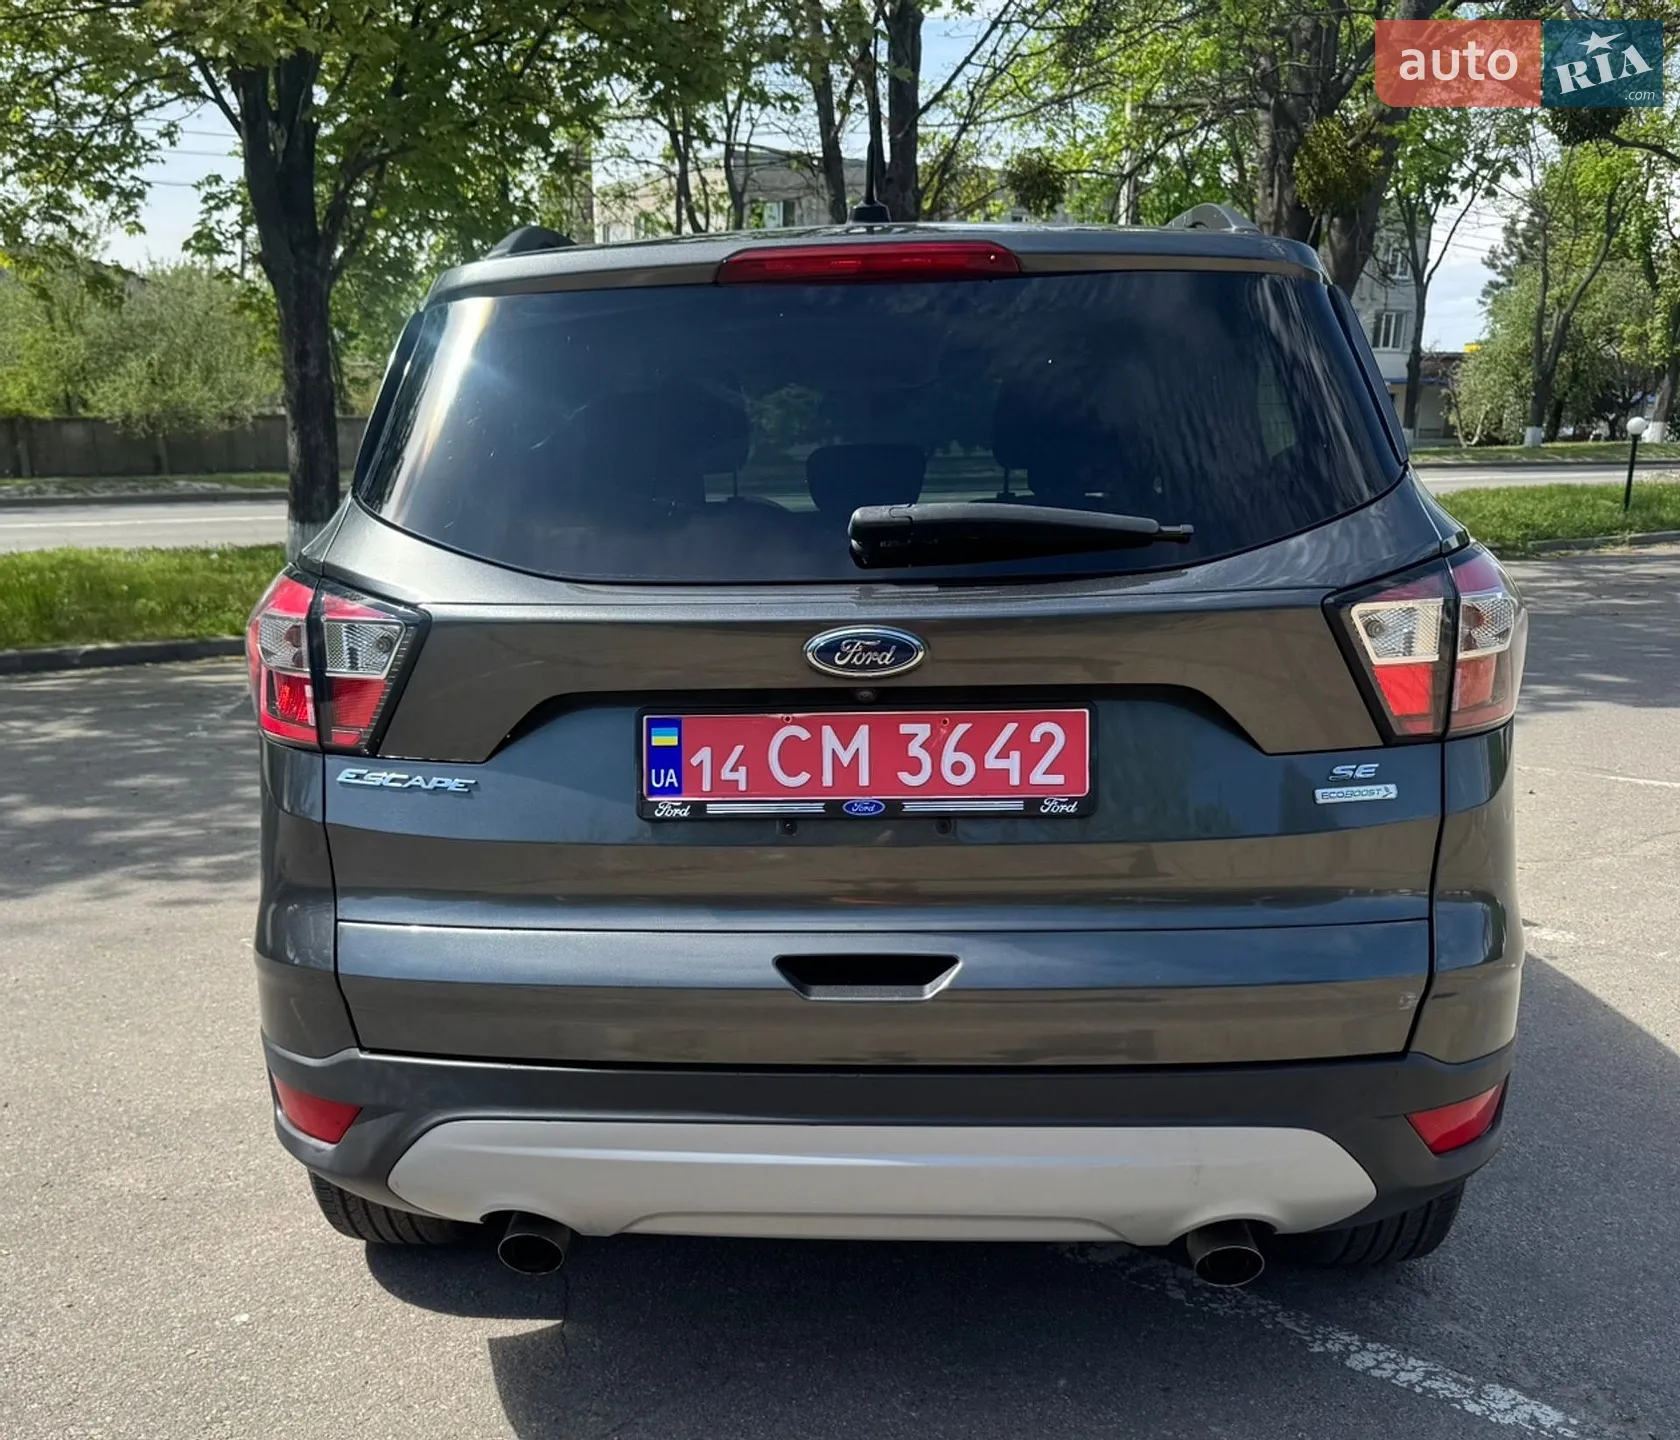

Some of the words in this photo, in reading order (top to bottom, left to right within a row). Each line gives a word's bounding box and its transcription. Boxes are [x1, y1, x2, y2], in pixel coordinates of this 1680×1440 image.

[834, 639, 897, 666] Ford
[690, 745, 747, 792] 14
[768, 724, 870, 787] CM
[896, 722, 1067, 786] 3642
[651, 768, 678, 788] UA
[1328, 763, 1380, 781] SE
[654, 801, 692, 818] Ford
[851, 801, 876, 813] Ford
[1039, 797, 1079, 814] Ford
